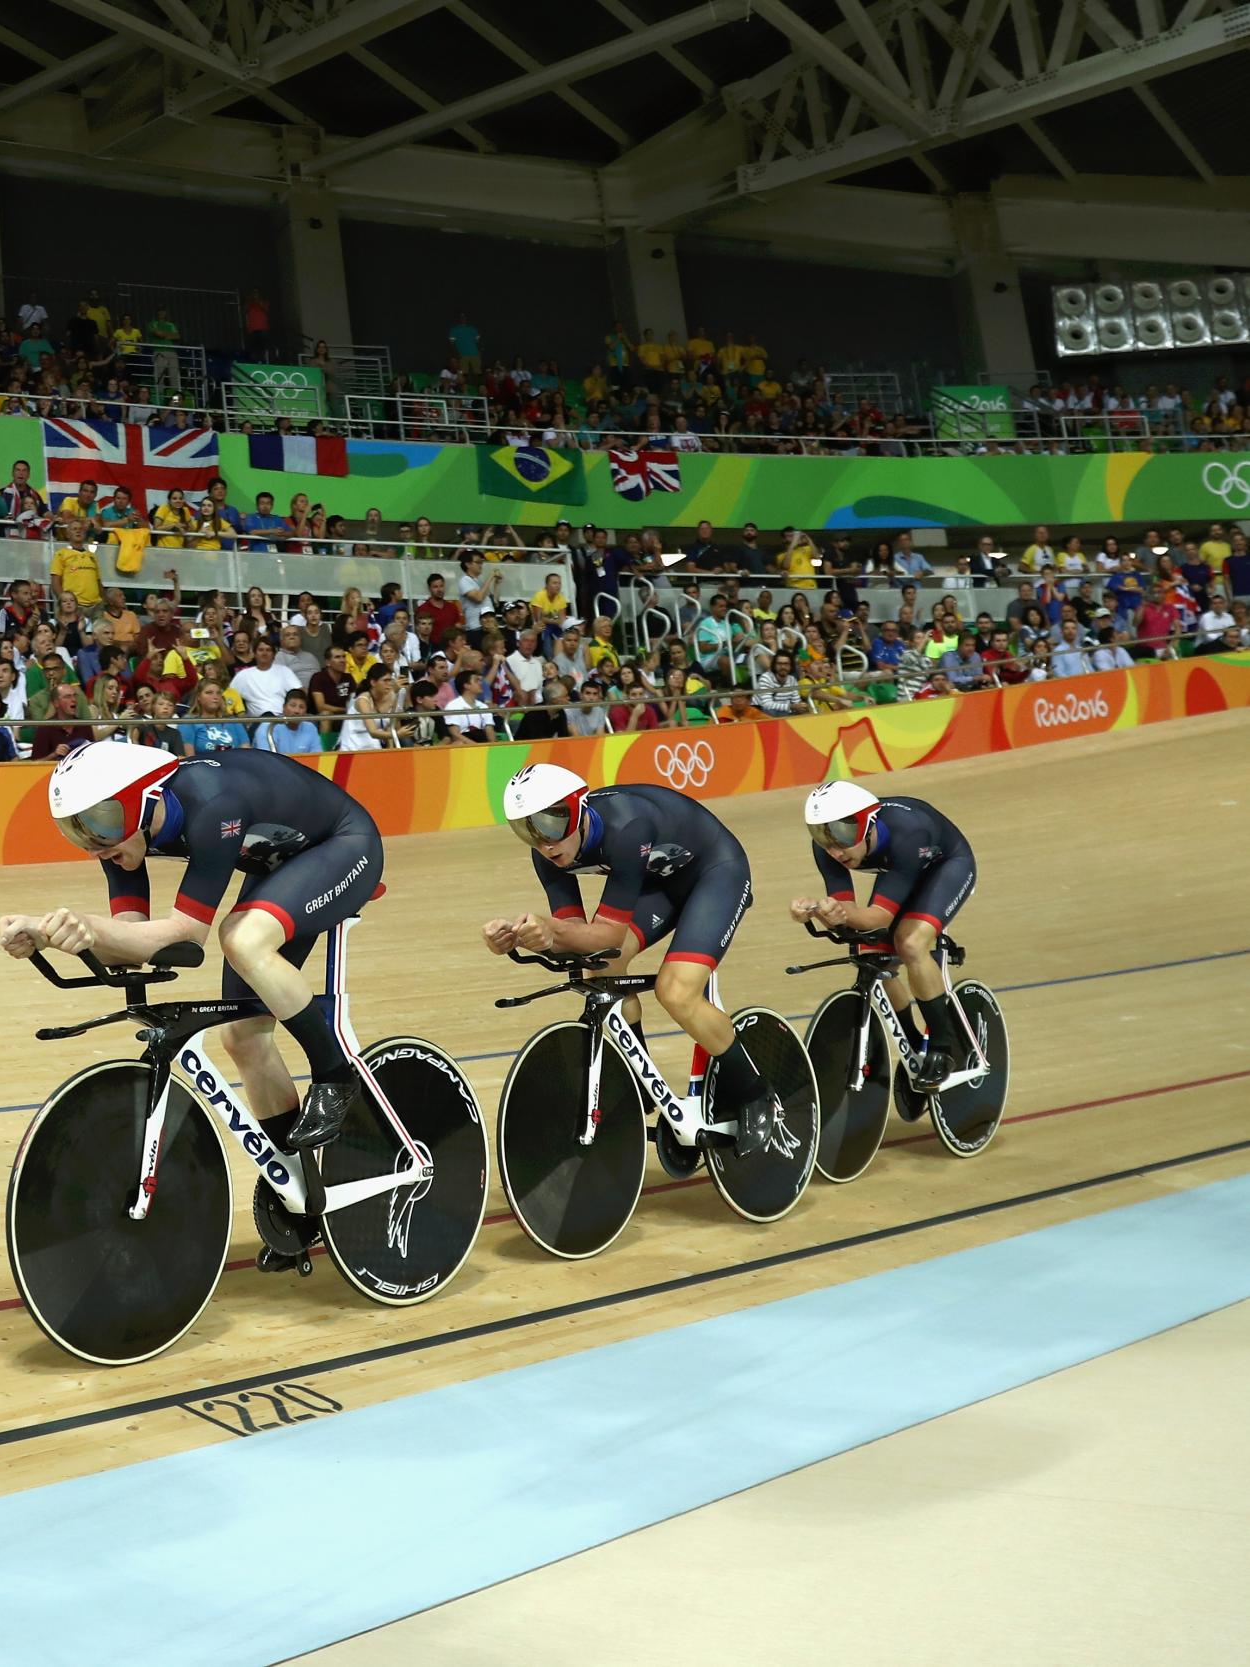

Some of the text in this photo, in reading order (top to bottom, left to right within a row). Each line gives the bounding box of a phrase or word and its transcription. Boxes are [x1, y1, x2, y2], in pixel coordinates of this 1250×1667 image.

[1034, 689, 1109, 728] Rio2016
[305, 855, 369, 914] GREAT BRITAIN
[720, 880, 750, 948] GREAT BRITAIN
[199, 1004, 239, 1013] GREAT BRITAIN
[607, 1012, 685, 1123] cervélo
[179, 1048, 291, 1187] cervélo
[354, 1266, 440, 1297] GHIBLI
